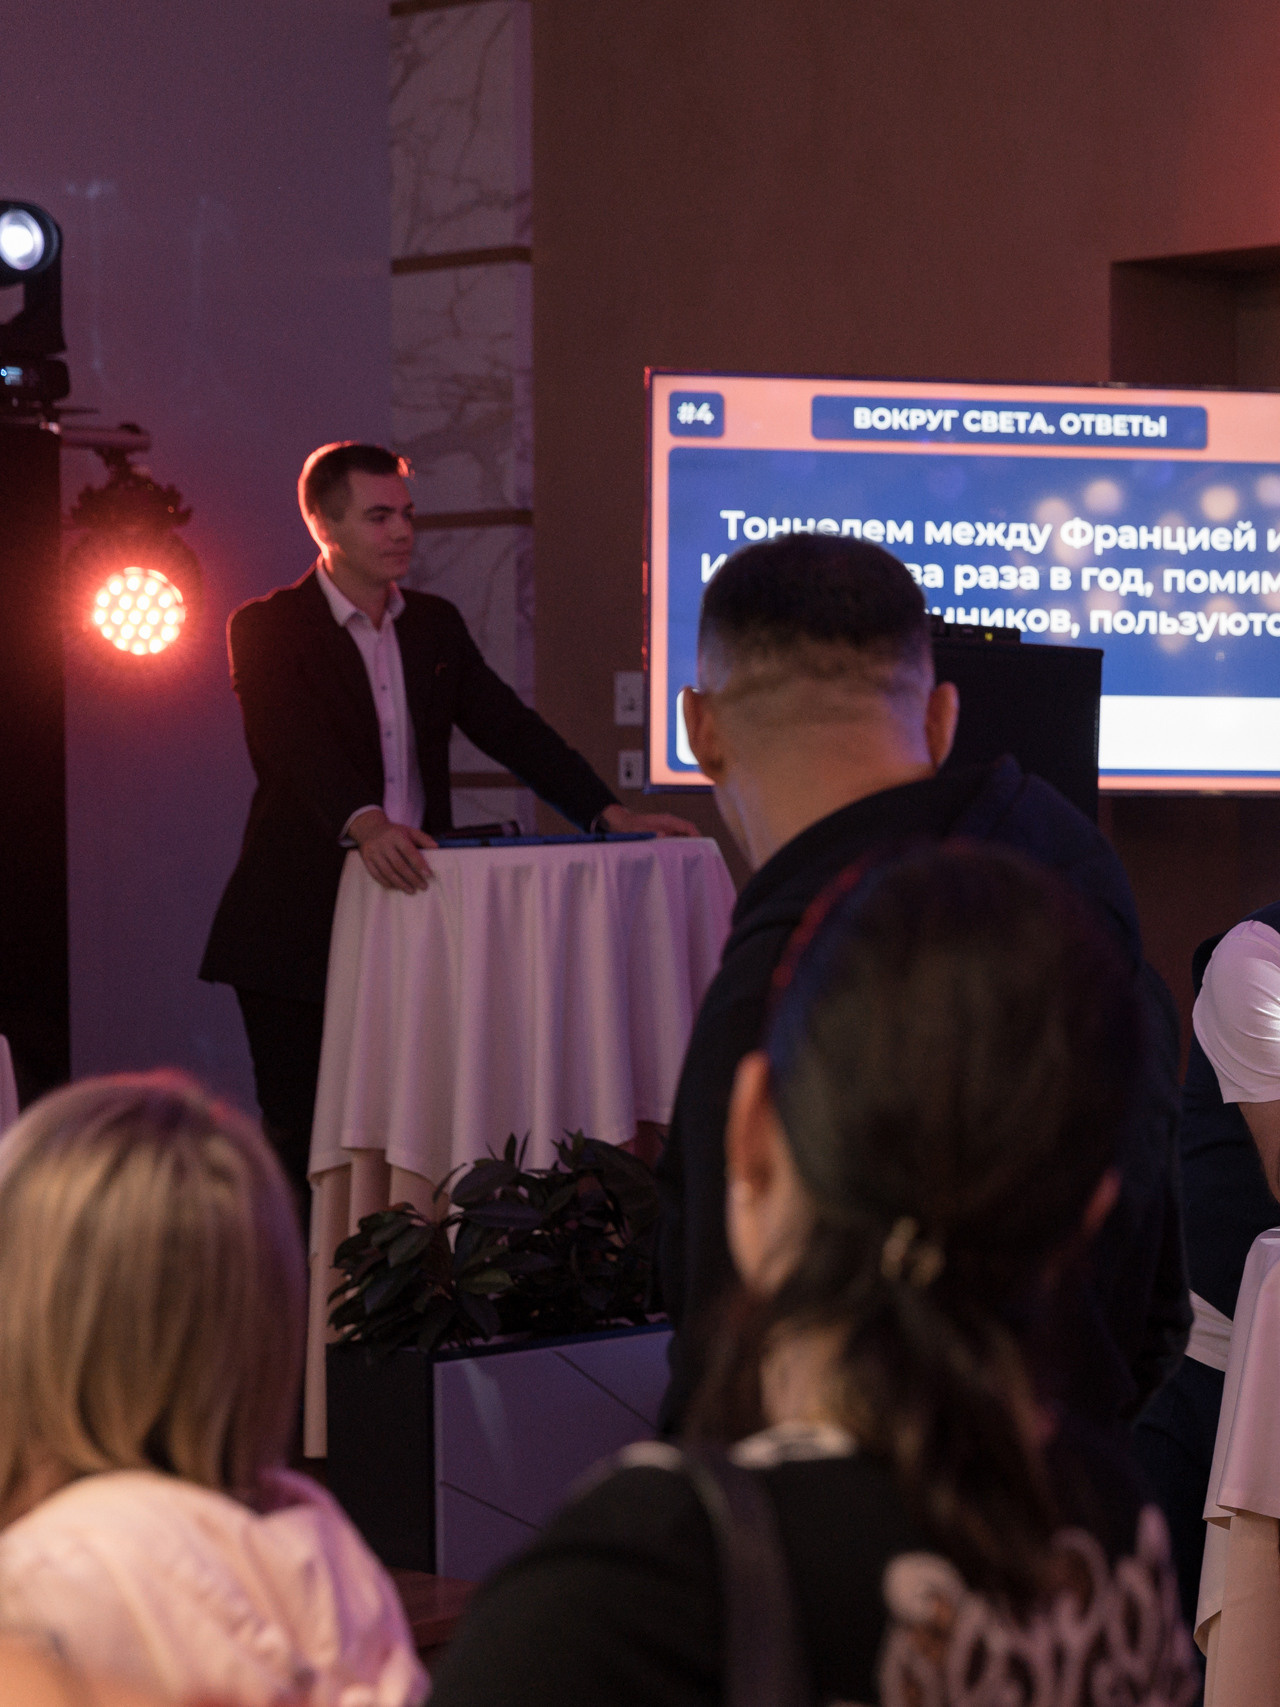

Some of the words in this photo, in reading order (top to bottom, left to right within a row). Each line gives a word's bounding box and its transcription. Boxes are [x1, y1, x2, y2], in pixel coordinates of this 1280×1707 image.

[677, 402, 714, 425] #4
[853, 406, 959, 431] ВОКРУГ
[962, 410, 1055, 435] СВЕТА.
[1060, 413, 1166, 437] ОТВЕТЫ
[924, 520, 1053, 554] между
[1060, 517, 1256, 555] Францией
[954, 564, 1040, 595] раза
[1050, 566, 1072, 590] в
[1081, 567, 1154, 597] год,
